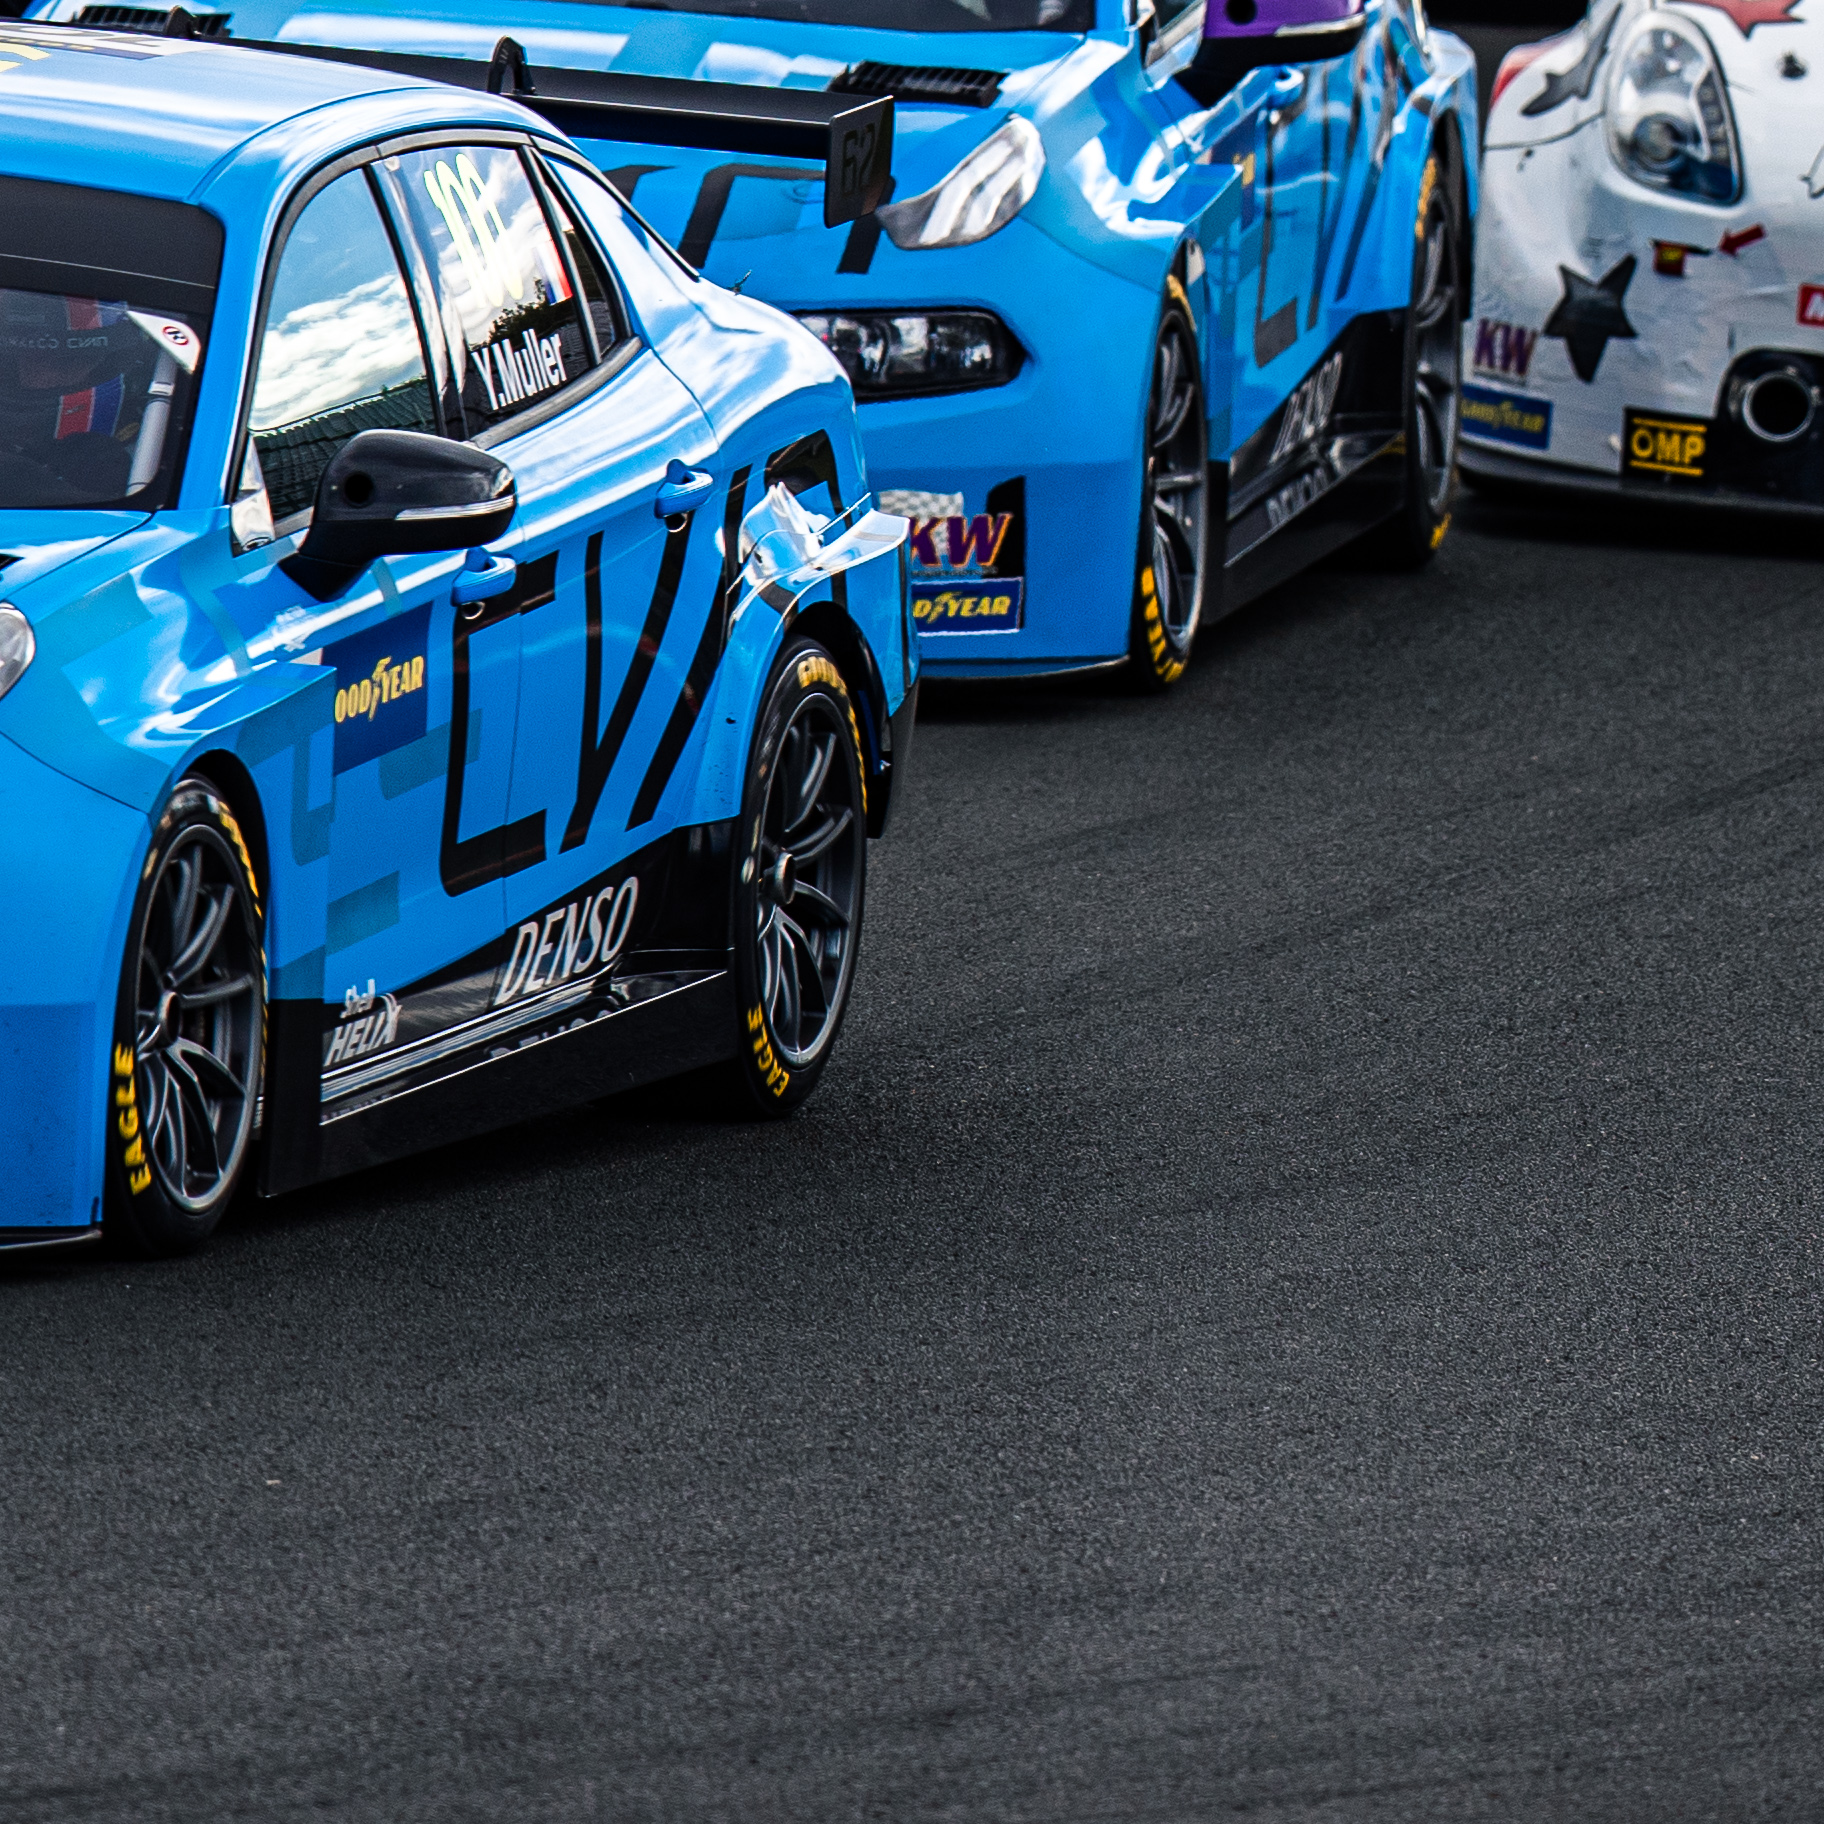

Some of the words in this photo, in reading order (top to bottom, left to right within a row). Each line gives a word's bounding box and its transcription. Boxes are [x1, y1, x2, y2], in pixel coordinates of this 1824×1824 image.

[469, 327, 569, 412] Y.Muller
[1631, 426, 1707, 466] OMP
[909, 511, 1015, 568] KW
[911, 590, 1013, 625] DYEAR
[334, 655, 425, 724] OODYEAR
[494, 875, 639, 1006] DENSO
[322, 991, 403, 1068] HELIX
[113, 1041, 153, 1197] EAGLE
